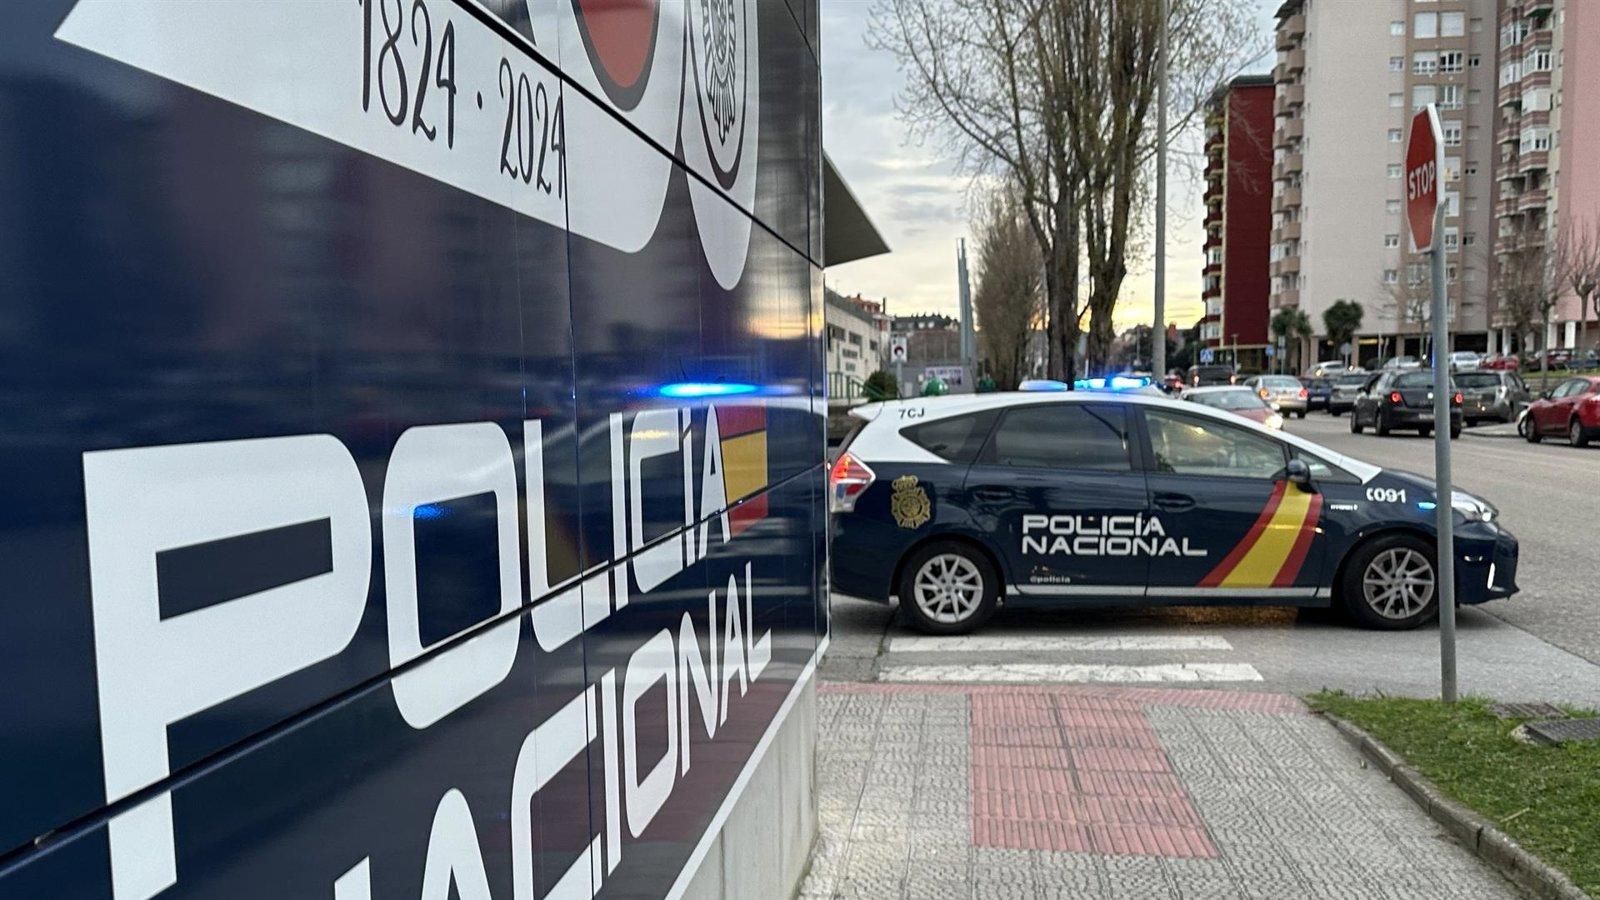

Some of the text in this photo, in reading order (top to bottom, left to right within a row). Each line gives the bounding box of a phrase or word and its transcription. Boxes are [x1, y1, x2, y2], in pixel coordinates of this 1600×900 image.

[358, 0, 457, 150] 1824
[499, 57, 564, 200] 2024
[1409, 160, 1435, 200] STOP
[898, 407, 925, 420] 7CJ
[1022, 512, 1166, 536] POLICÍA
[1022, 535, 1208, 557] NACIONAL
